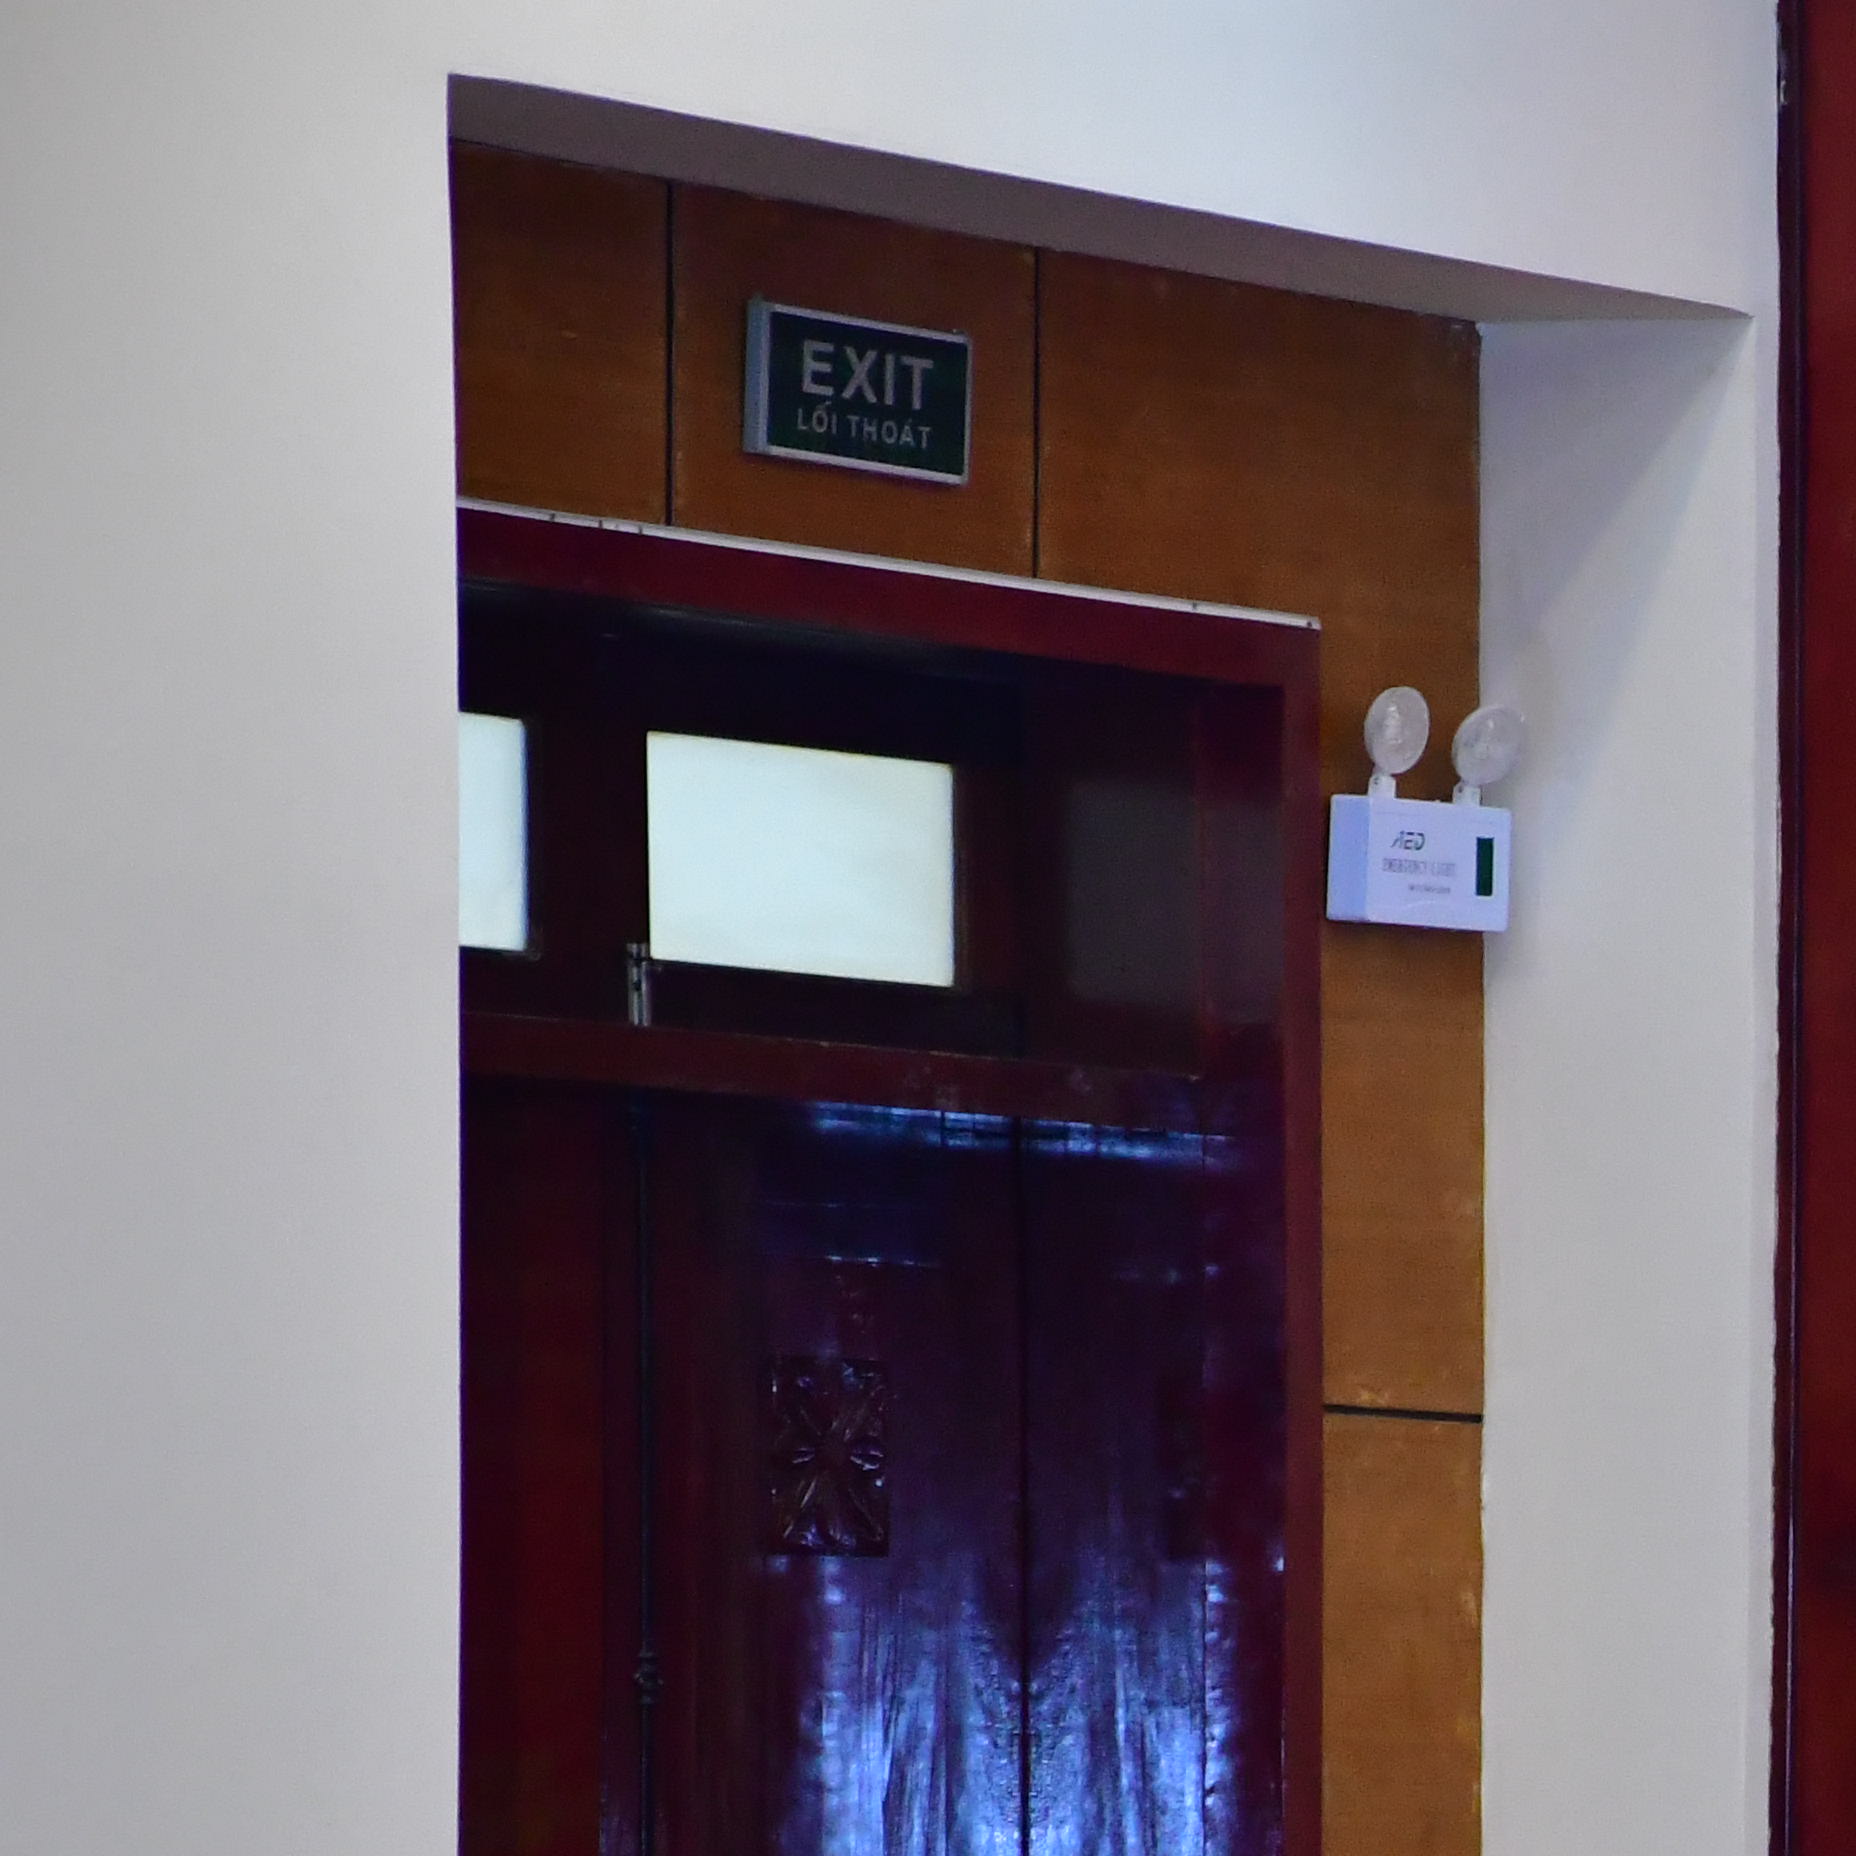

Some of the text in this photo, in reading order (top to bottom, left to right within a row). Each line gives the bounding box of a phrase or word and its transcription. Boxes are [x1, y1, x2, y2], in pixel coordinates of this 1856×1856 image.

[802, 340, 934, 411] EXIT
[797, 400, 933, 449] LỐI THOÁT
